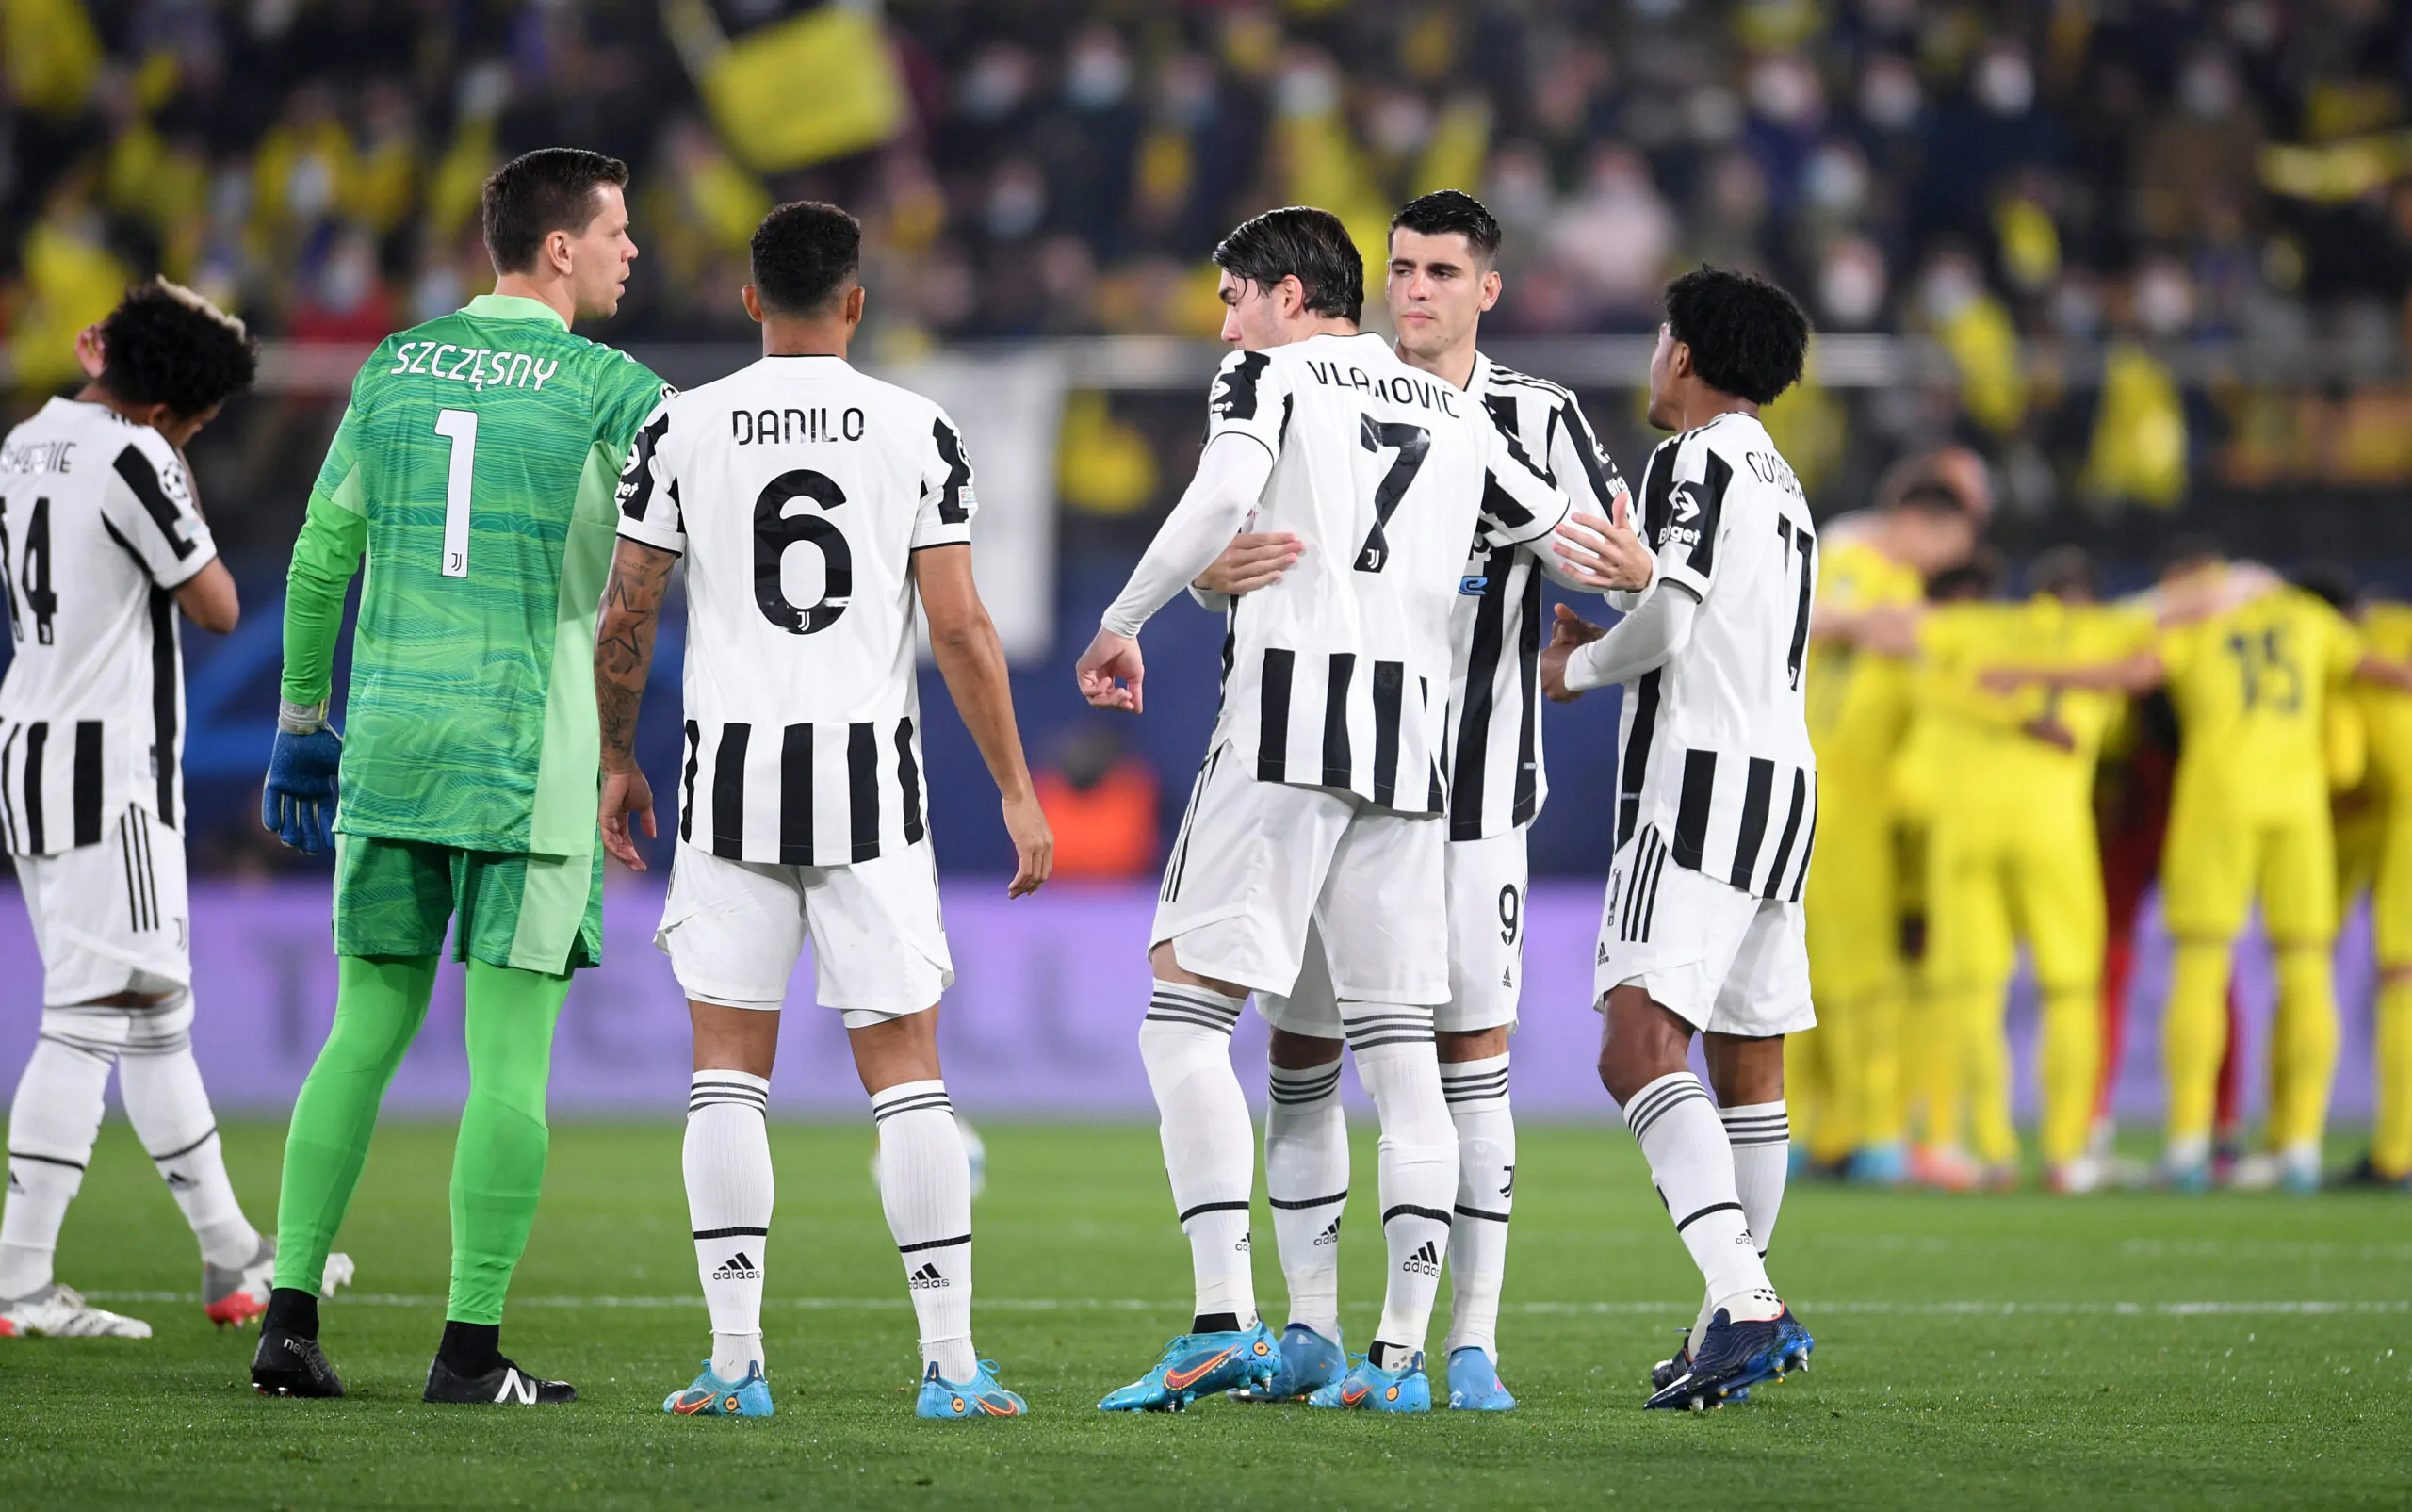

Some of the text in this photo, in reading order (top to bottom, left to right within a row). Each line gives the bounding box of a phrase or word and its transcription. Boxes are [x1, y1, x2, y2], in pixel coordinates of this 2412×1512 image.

[390, 341, 559, 392] SZCZĘSNY
[732, 407, 864, 445] DANILO
[434, 408, 478, 578] 1
[1353, 412, 1431, 573] 7
[753, 469, 853, 635] 6
[1777, 512, 1814, 692] 11
[1499, 884, 1518, 946] 9
[712, 1268, 761, 1281] adidas
